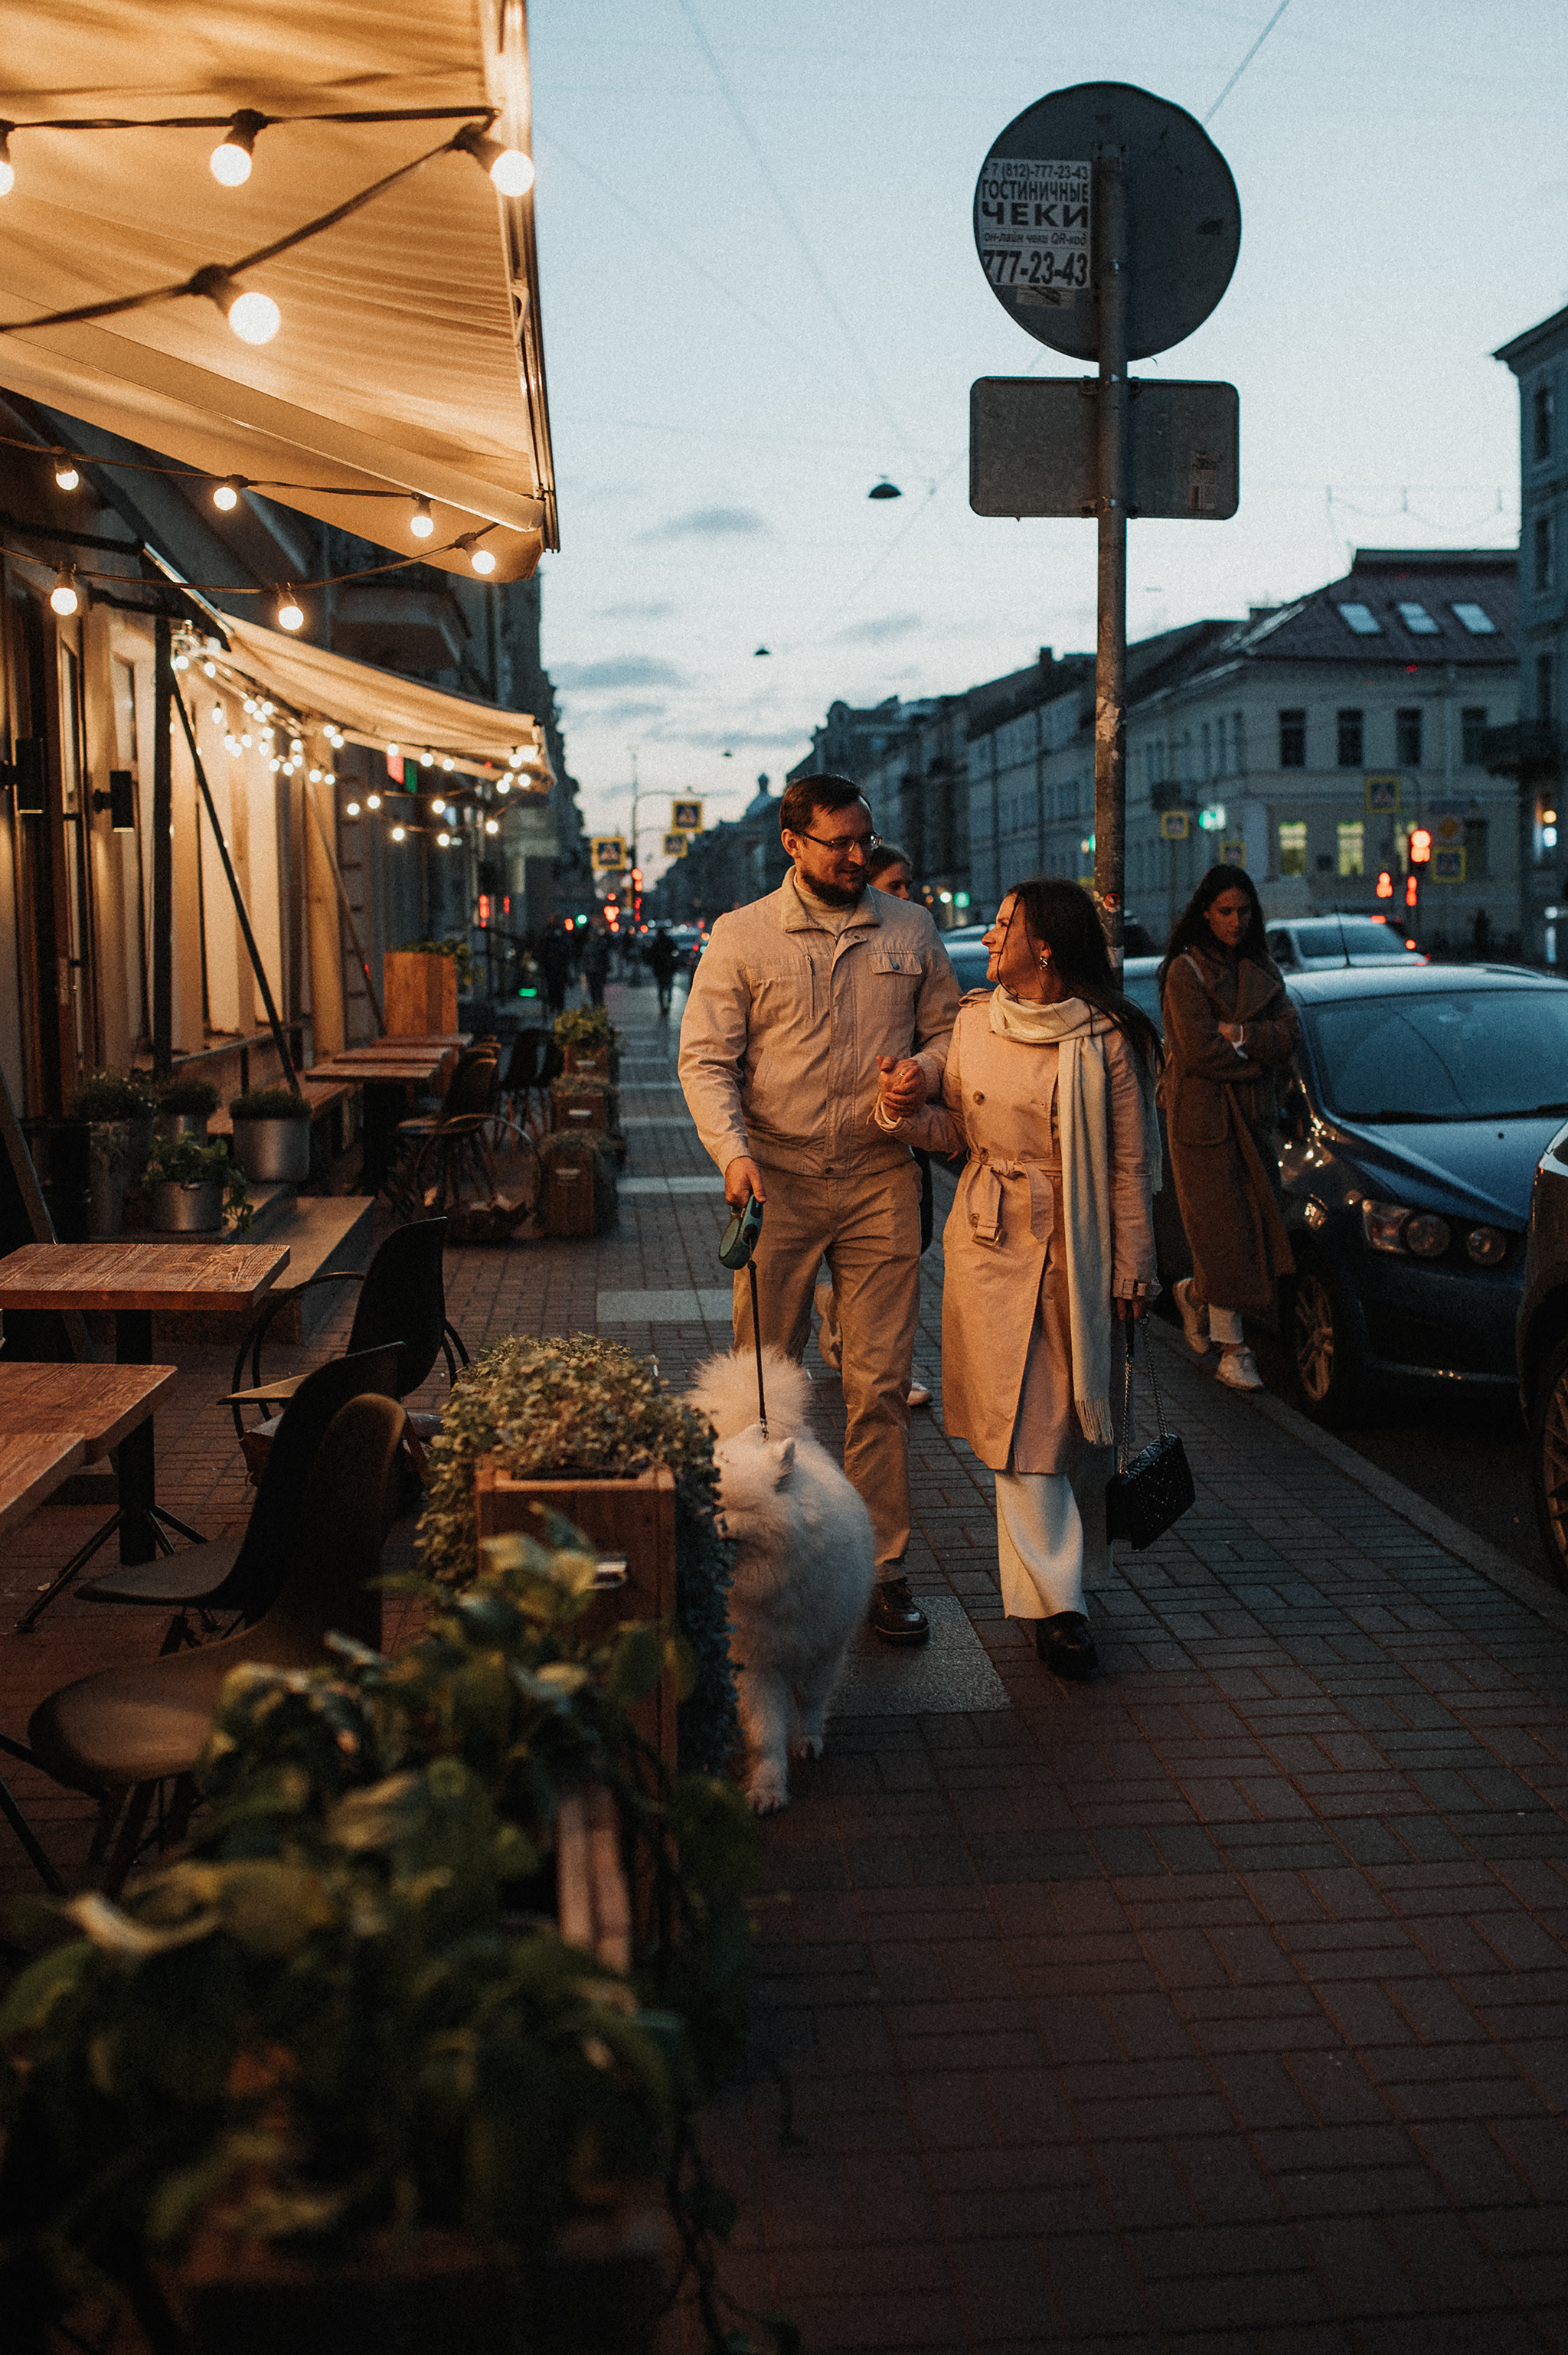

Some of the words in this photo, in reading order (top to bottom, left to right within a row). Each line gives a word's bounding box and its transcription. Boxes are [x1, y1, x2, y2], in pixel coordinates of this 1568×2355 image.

[1002, 162, 1088, 180] (812)-777-23-43
[982, 179, 1089, 203] ГОСТИНИЧНЫЕ
[982, 201, 1089, 228] ЧЕКИ
[982, 249, 1088, 287] 777-23-43
